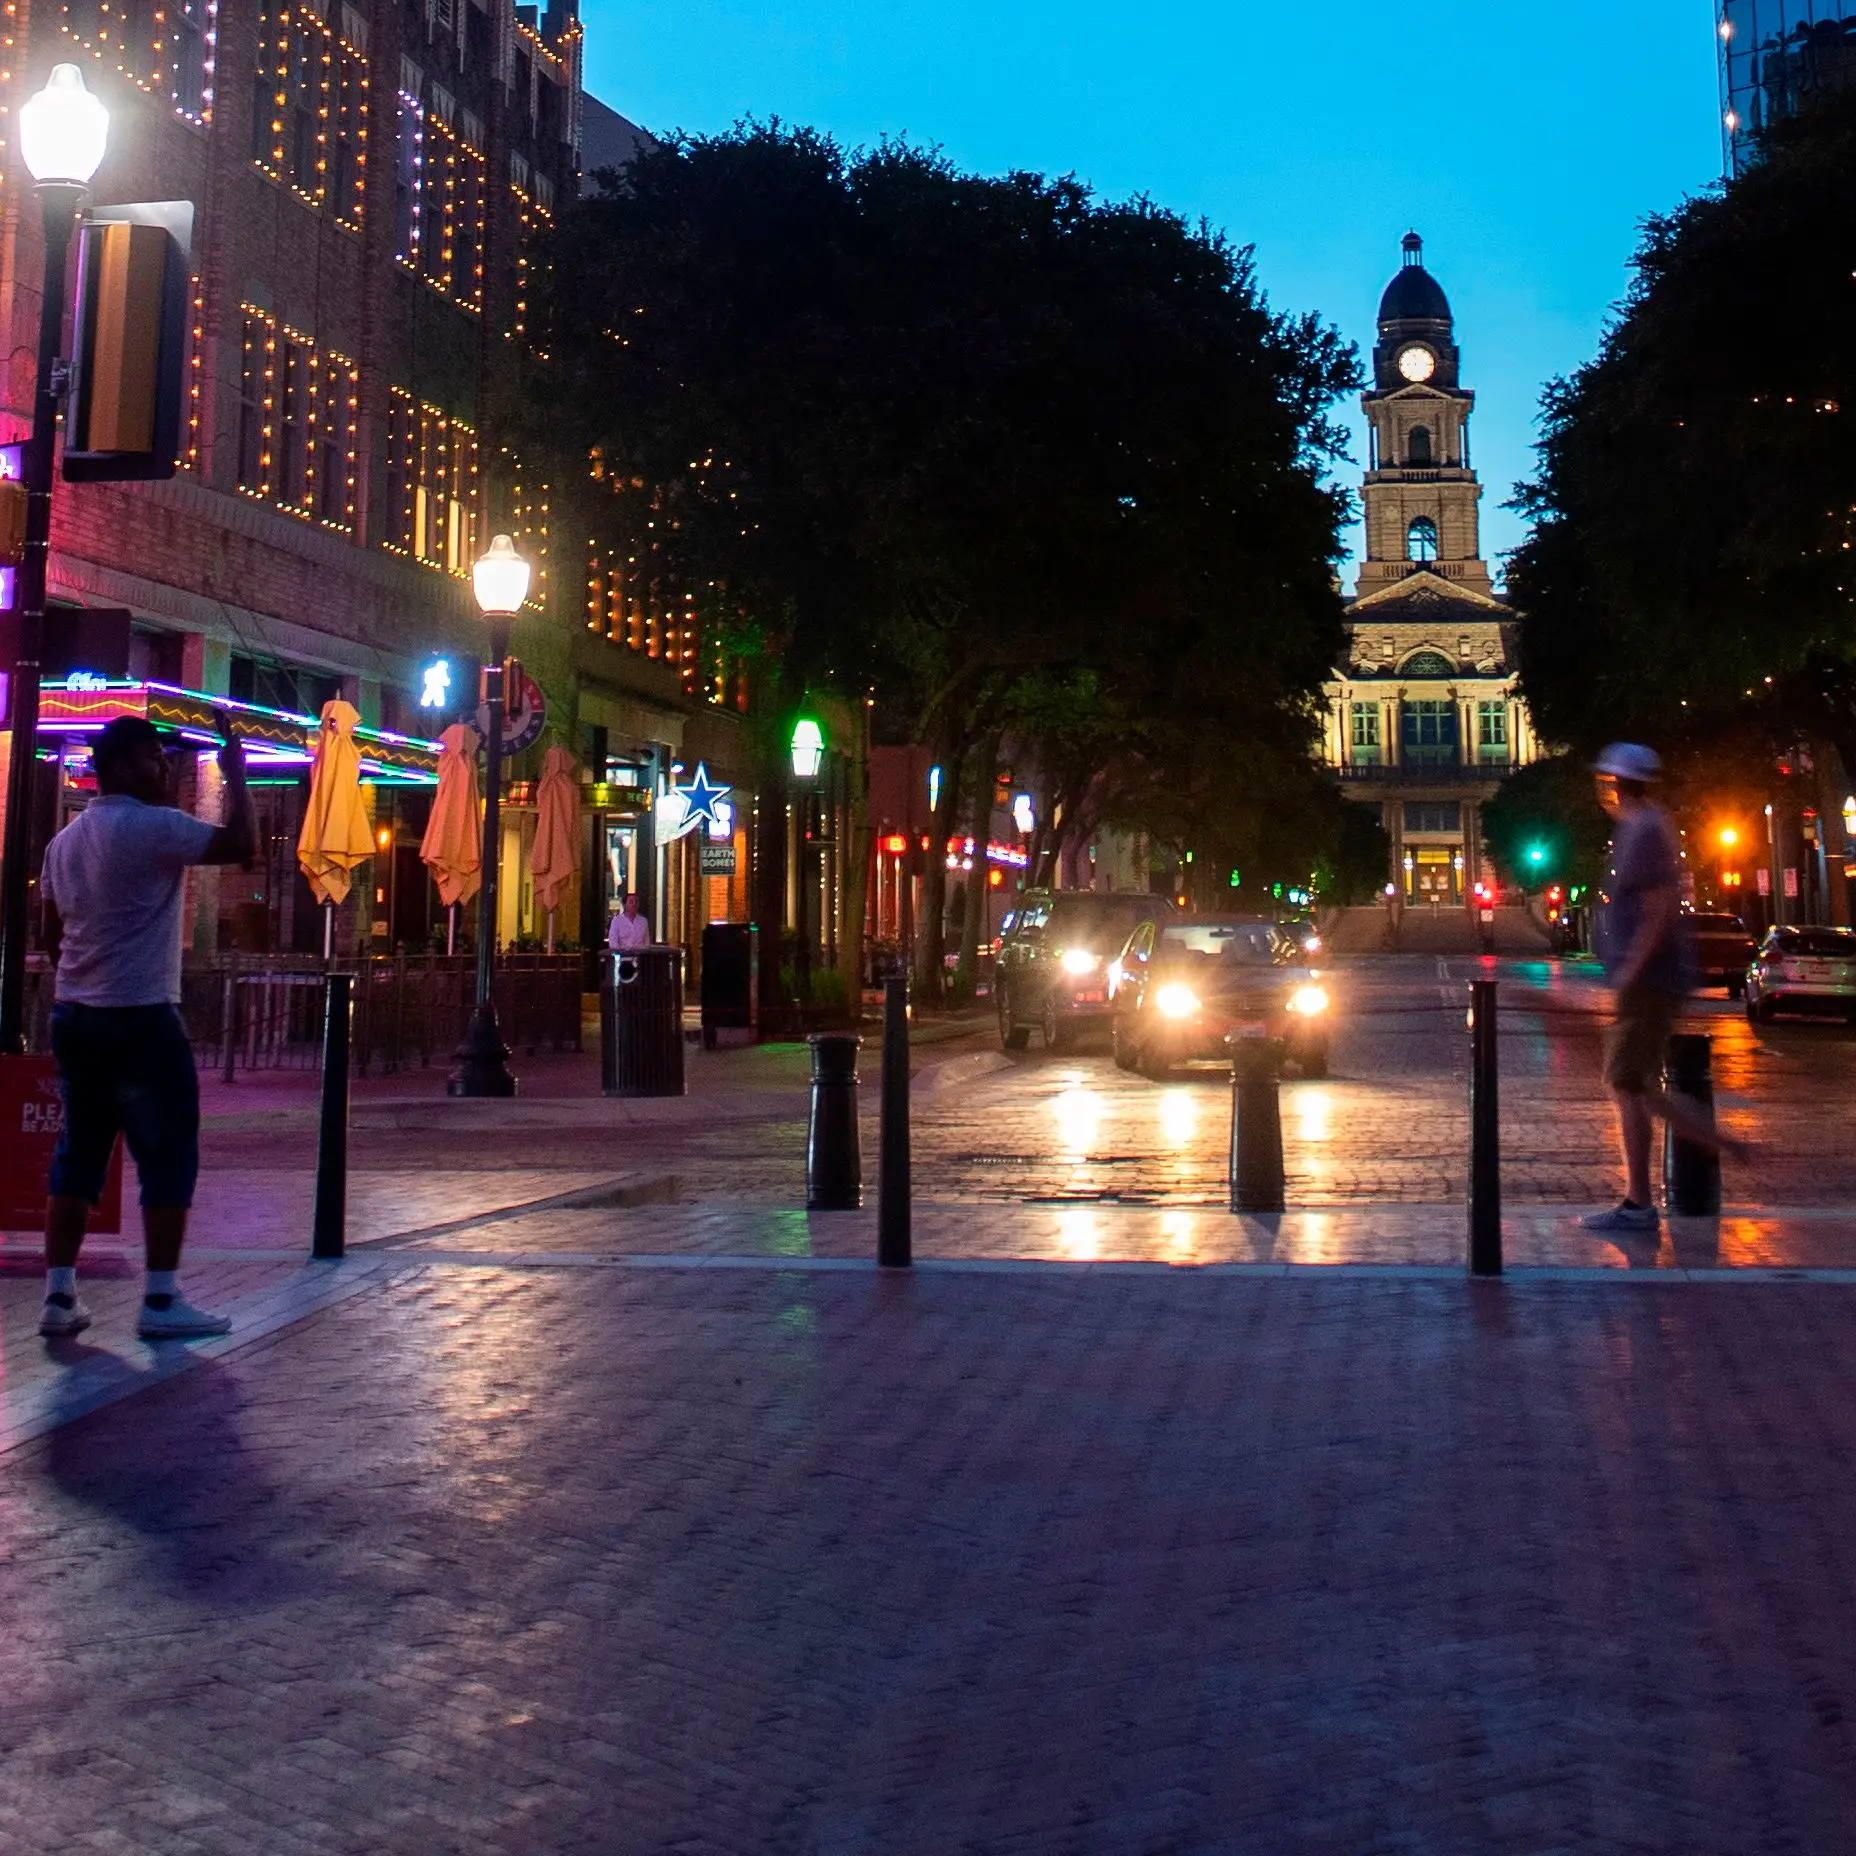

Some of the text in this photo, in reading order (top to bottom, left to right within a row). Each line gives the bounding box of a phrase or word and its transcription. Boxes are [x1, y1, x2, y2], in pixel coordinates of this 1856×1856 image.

[702, 848, 736, 858] EARTH
[21, 1102, 68, 1120] PLEA
[20, 1120, 37, 1133] BE
